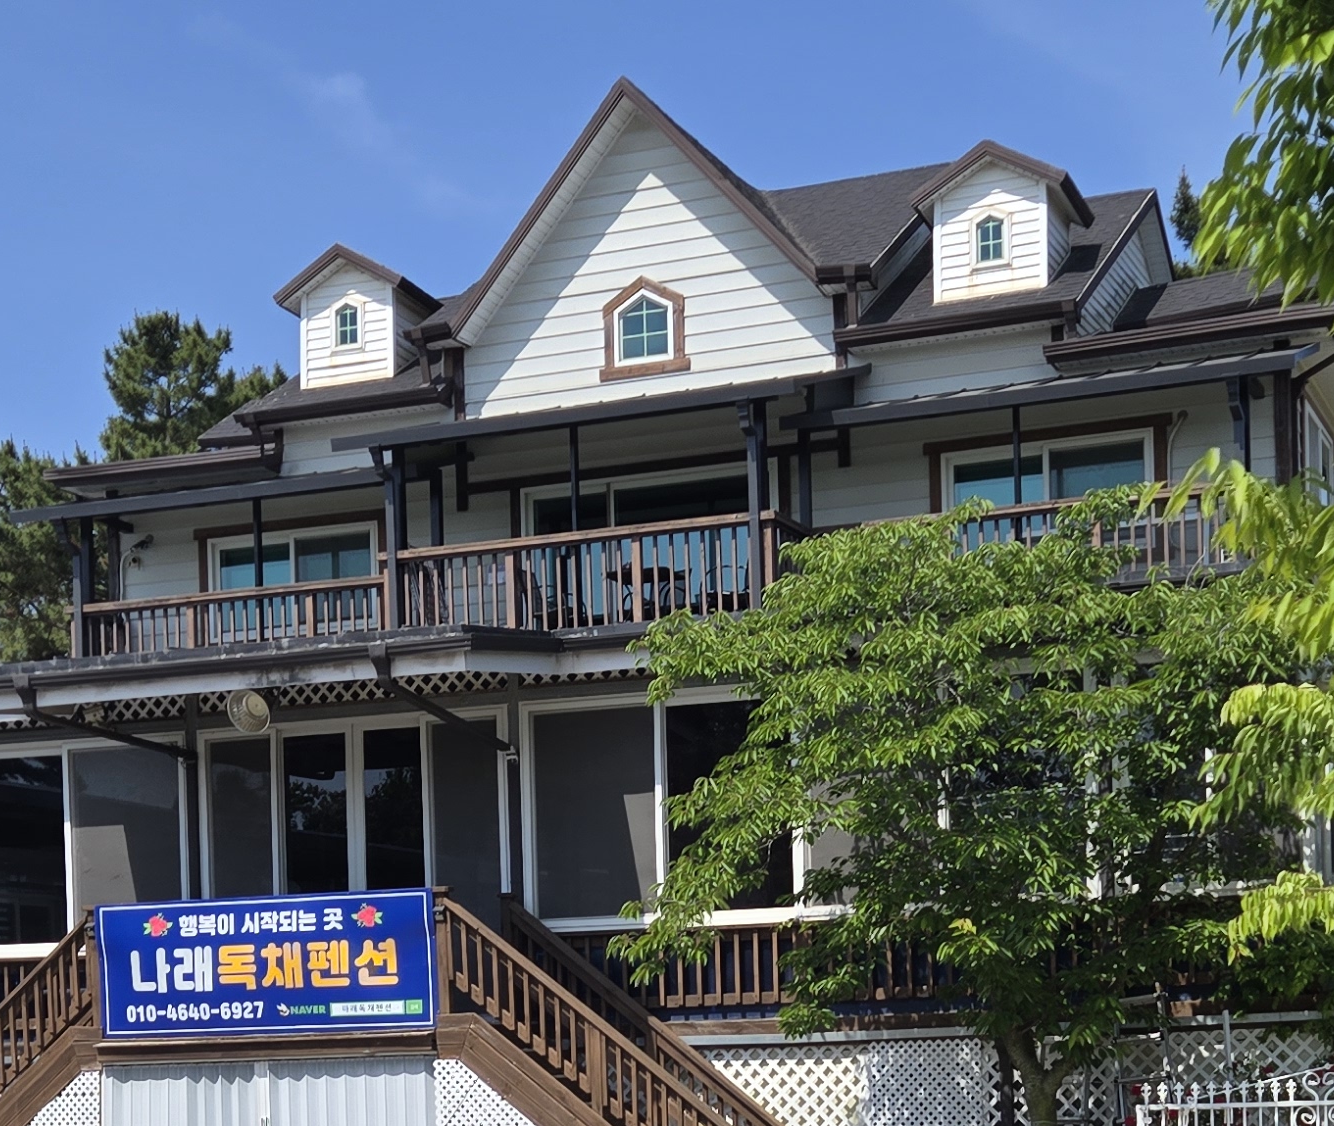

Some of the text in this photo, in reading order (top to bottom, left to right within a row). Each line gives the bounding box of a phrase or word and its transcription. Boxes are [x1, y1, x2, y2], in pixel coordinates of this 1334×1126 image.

[178, 907, 343, 937] 행복이 시작되는 곳
[130, 937, 399, 994] 나래독채펜션
[126, 1001, 264, 1023] 010-4640-6927
[290, 1004, 327, 1016] NAVER
